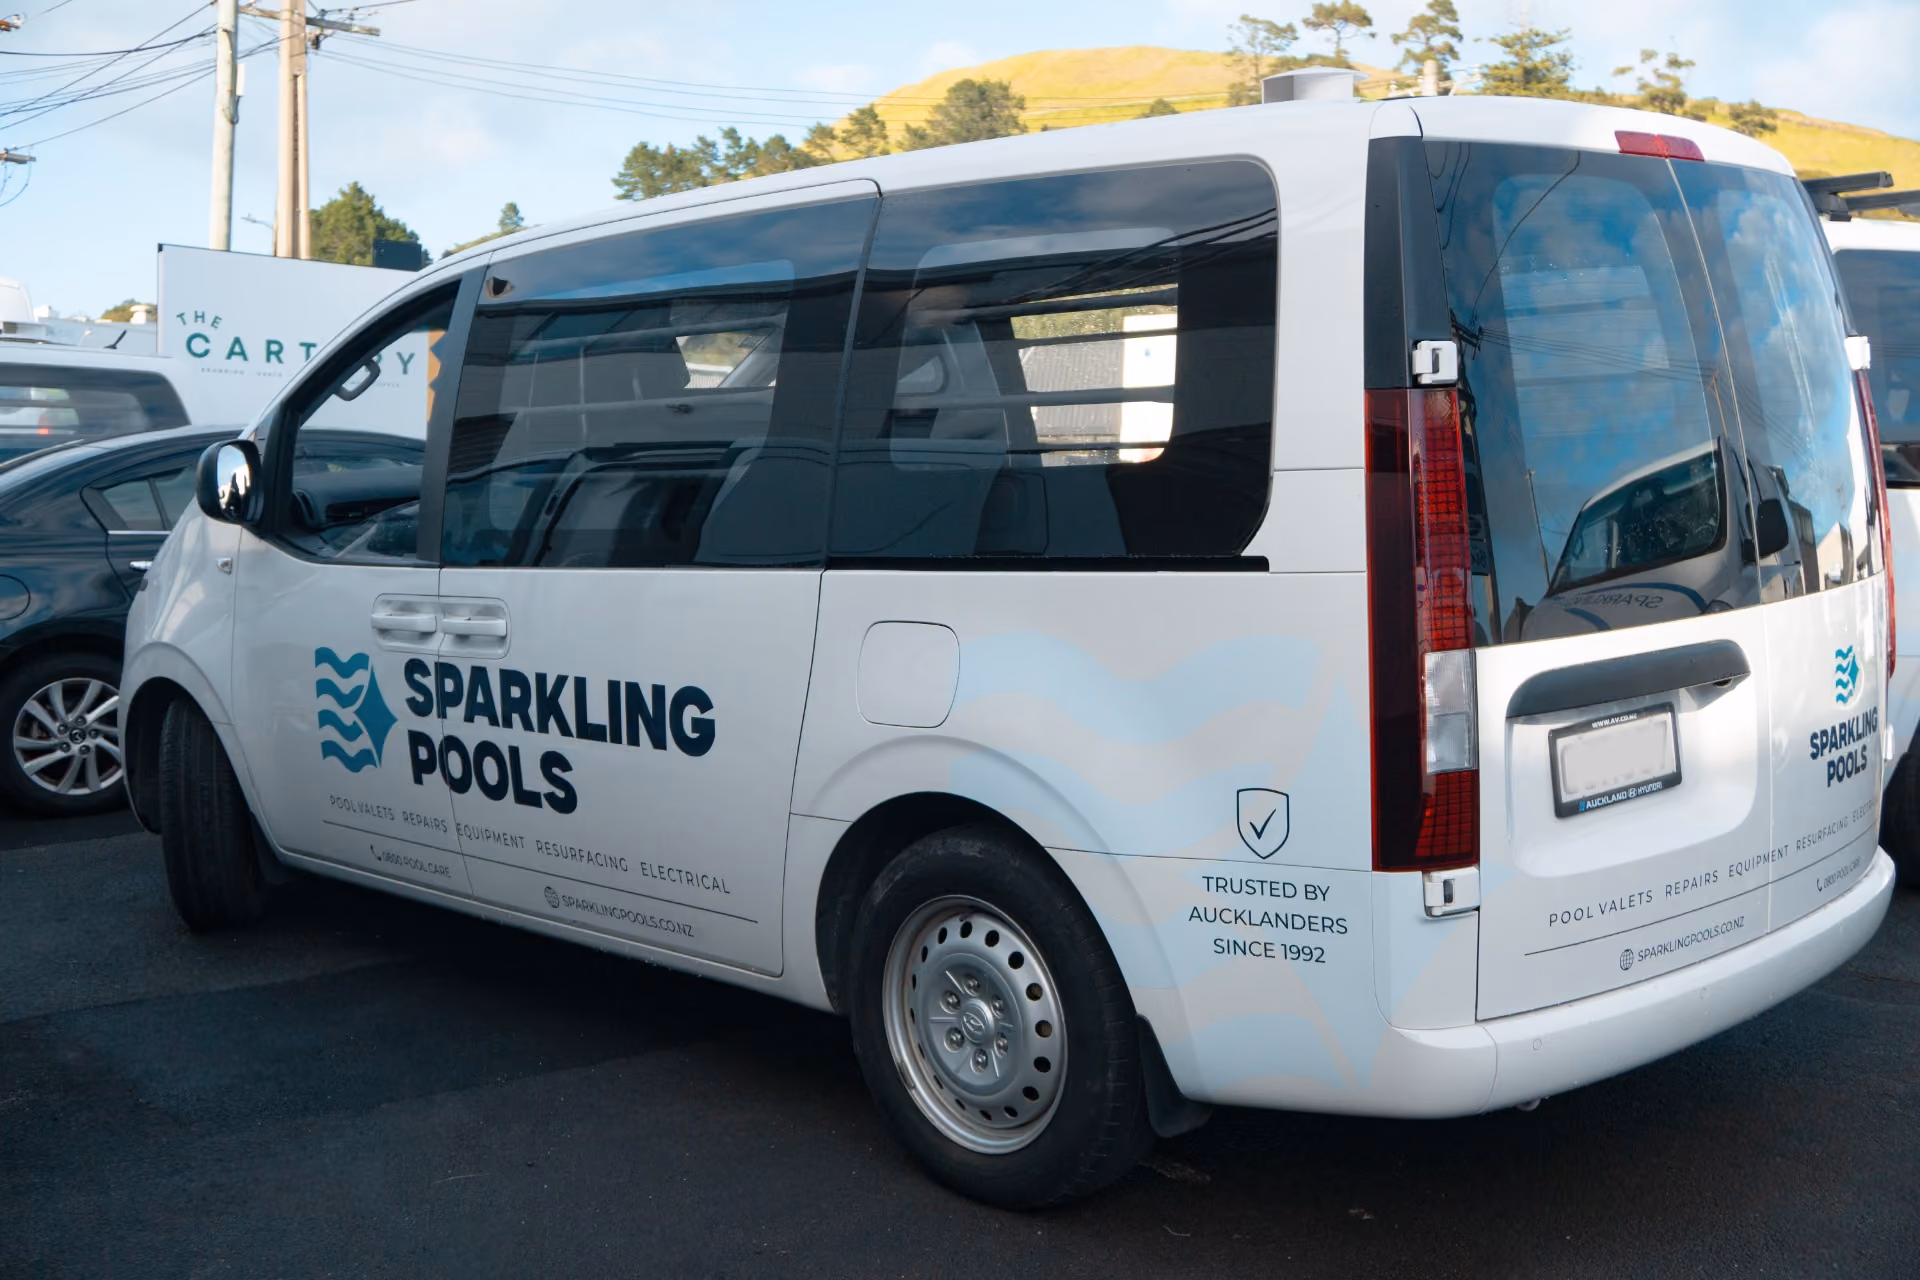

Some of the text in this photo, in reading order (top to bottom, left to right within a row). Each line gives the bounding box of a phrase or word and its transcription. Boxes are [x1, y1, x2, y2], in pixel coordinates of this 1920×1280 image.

[176, 310, 222, 329] THE
[186, 332, 415, 375] CARTY
[404, 658, 716, 757] SPARKLING
[1810, 706, 1878, 760] SPARKLING
[407, 729, 578, 815] POOLS
[1827, 744, 1868, 788] POOLS
[1585, 790, 1627, 810] AUCKLAND
[402, 810, 448, 833] REPAIRS
[456, 822, 525, 849] EQUIPMENT
[535, 839, 629, 873] RESURFACING
[640, 861, 731, 894] ELECTRICAL
[1665, 869, 1719, 899] REPAIRS
[1728, 844, 1789, 878] EQUIPMENT
[1796, 815, 1849, 852] RESURFACING
[1202, 875, 1330, 902] TRUSTED BY
[561, 894, 695, 938] SPARKLINGPOOLS.CO.NZ
[1188, 905, 1348, 935] AUCKLANDERS
[1213, 937, 1326, 964] SINCE 1992
[1637, 915, 1745, 963] SPARKLINGPOOLS.CO.NZ
